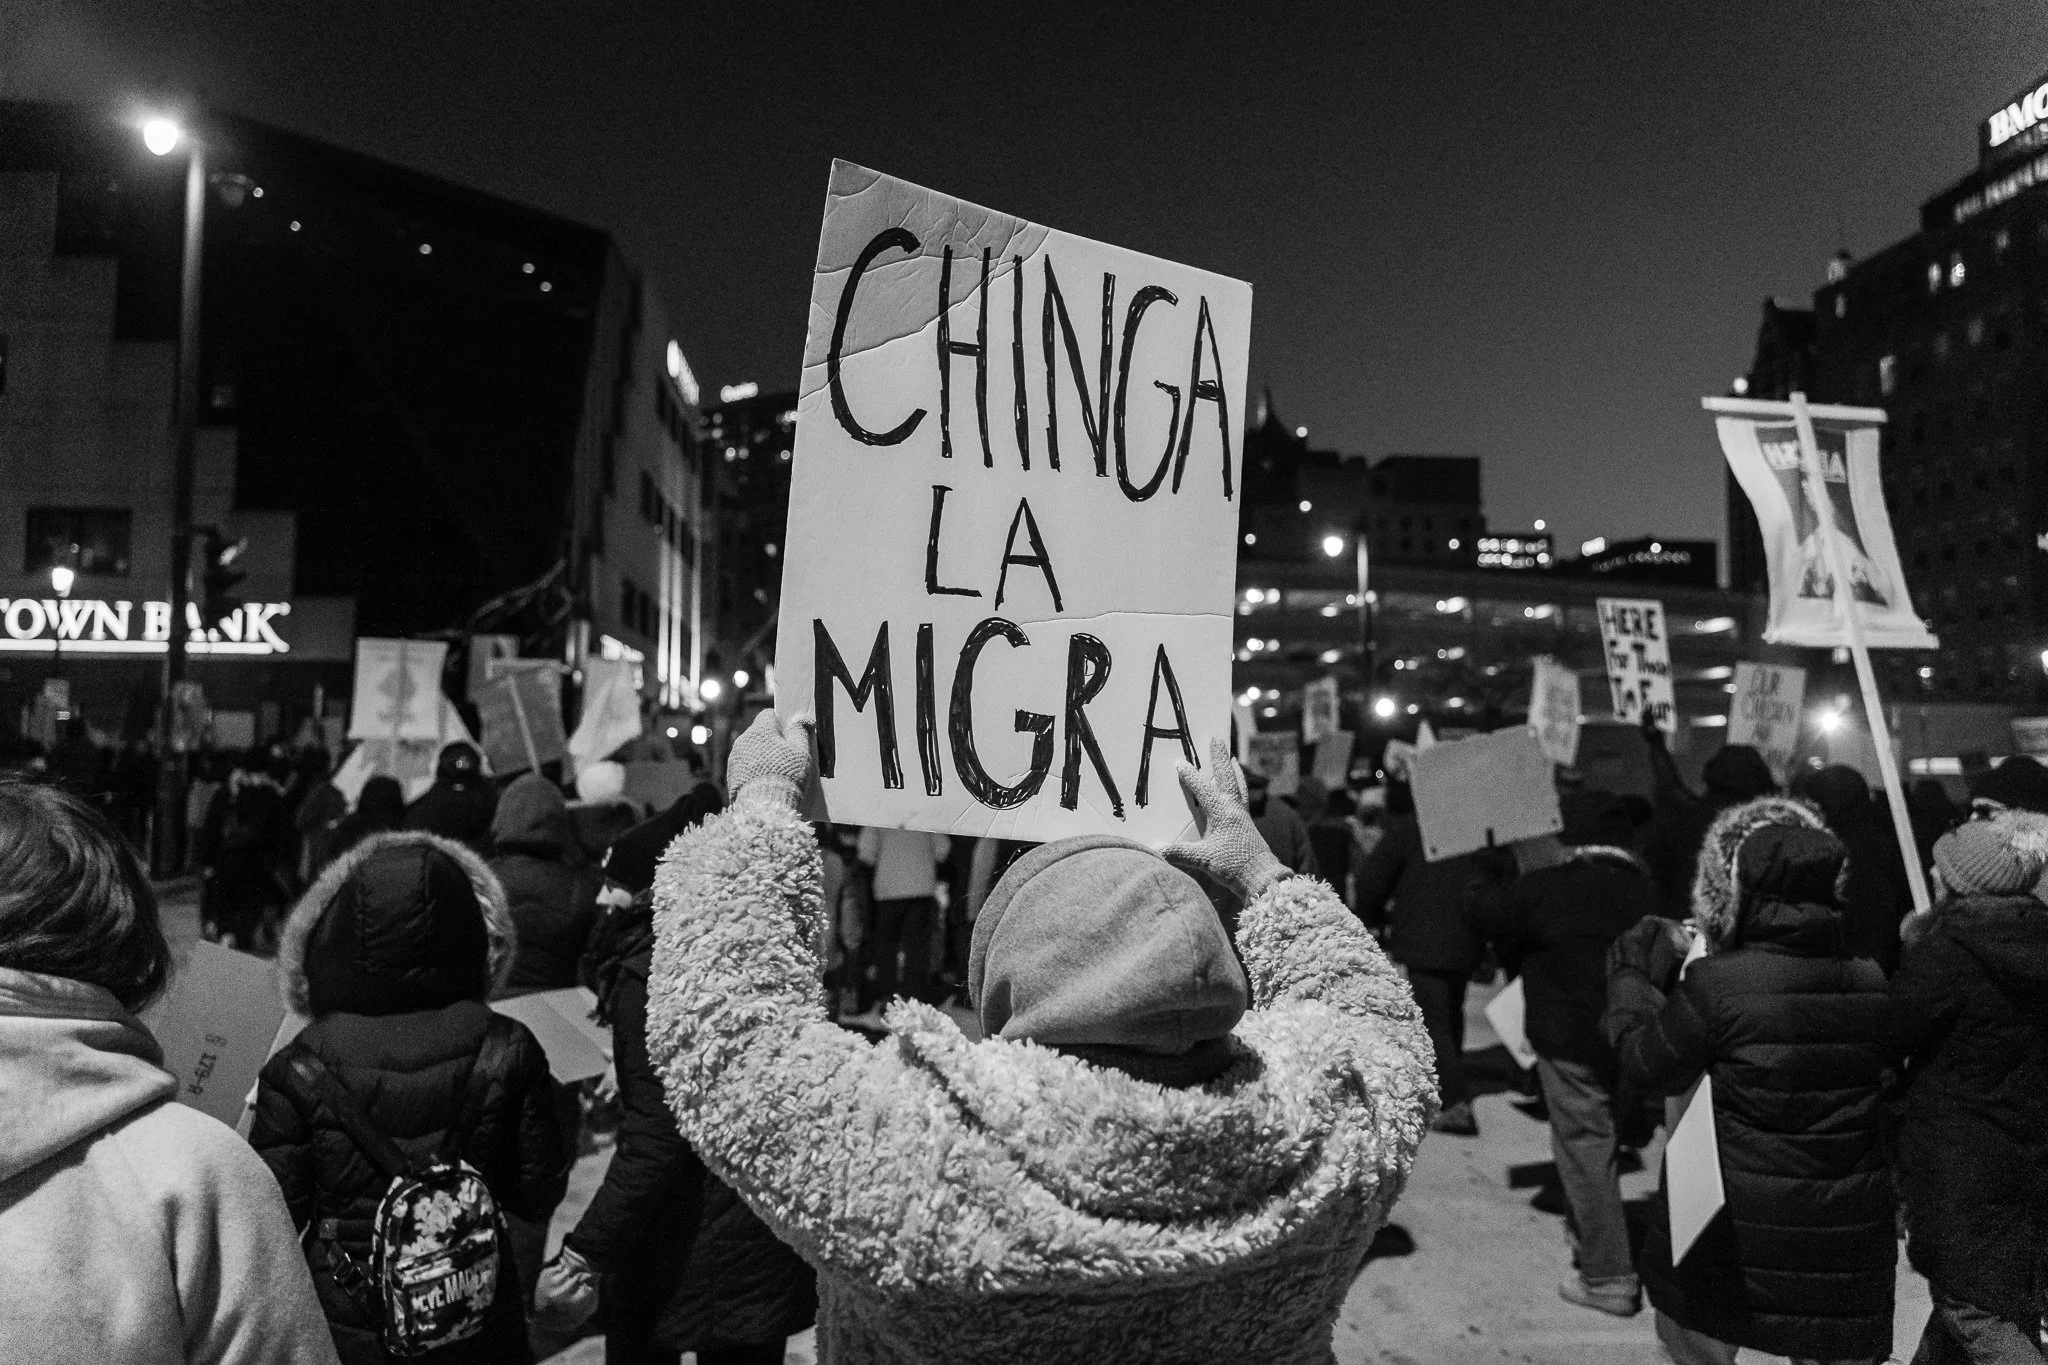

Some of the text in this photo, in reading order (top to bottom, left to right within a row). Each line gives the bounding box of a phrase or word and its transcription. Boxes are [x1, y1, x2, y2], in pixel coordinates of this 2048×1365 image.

[827, 226, 1233, 502] CHINGA
[0, 598, 133, 641] OWN
[924, 484, 1064, 612] LA
[812, 616, 1202, 822] MIGRA
